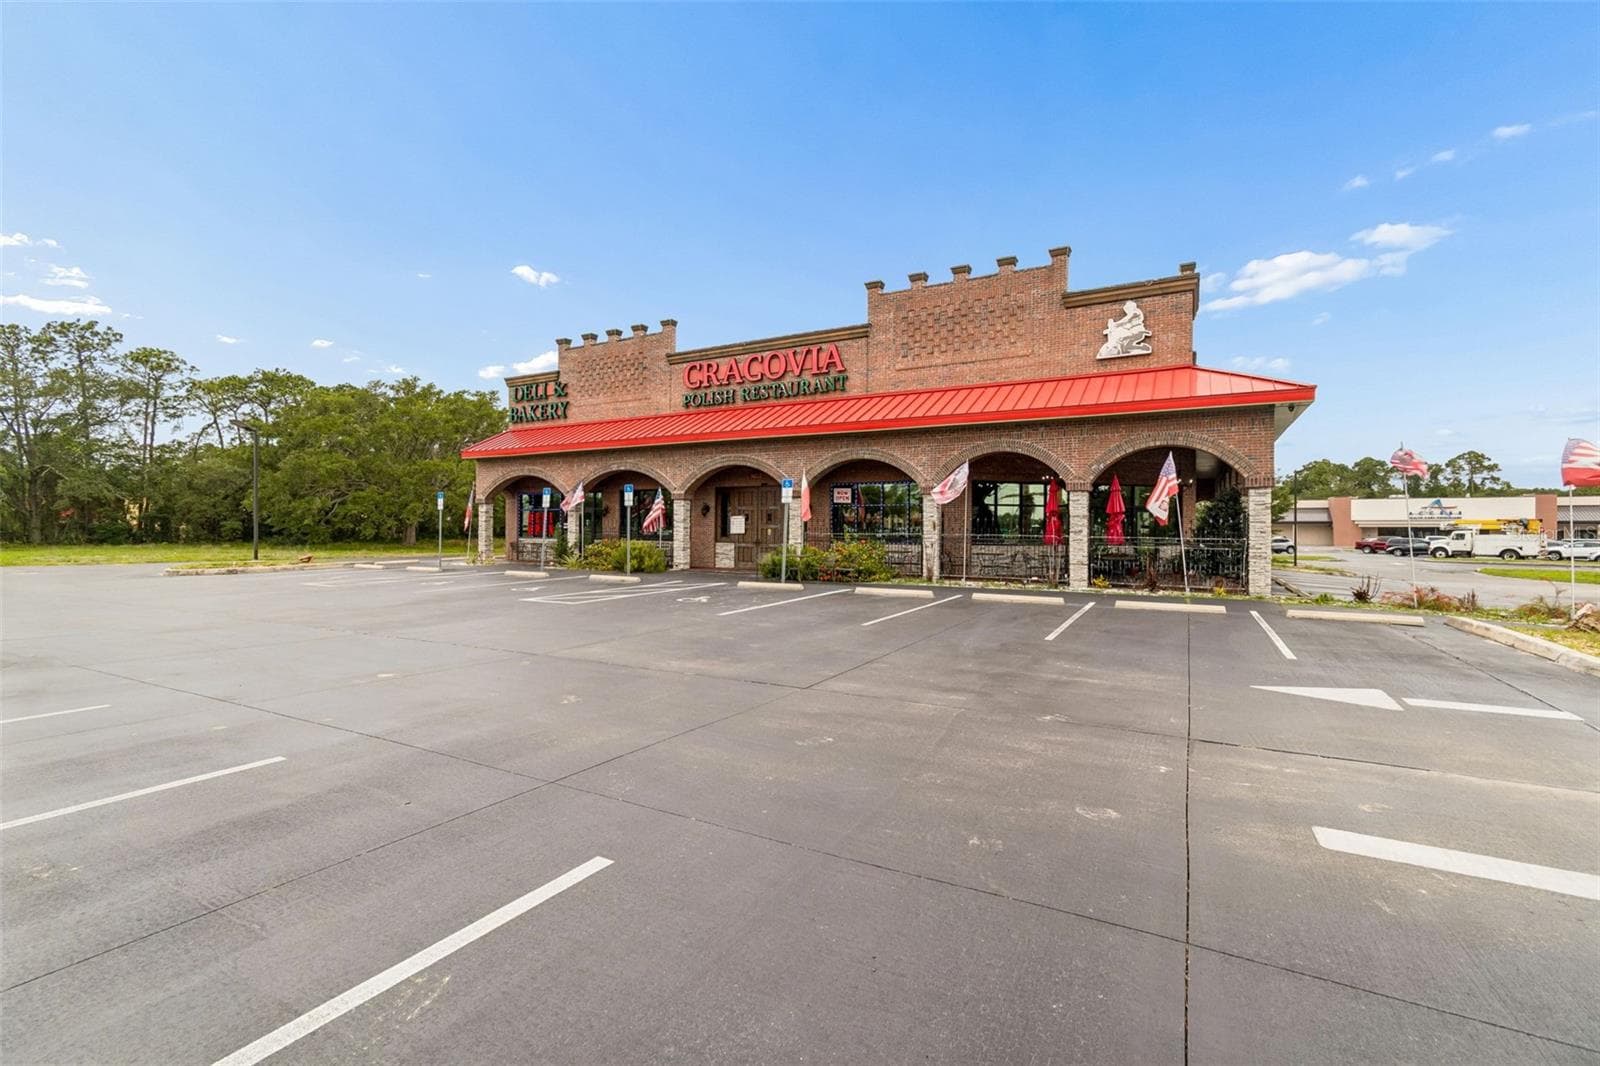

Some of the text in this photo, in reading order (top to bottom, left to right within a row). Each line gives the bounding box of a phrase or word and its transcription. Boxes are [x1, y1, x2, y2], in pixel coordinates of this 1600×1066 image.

[683, 342, 846, 389] CRACOVIA
[511, 380, 568, 402] DELI &
[682, 375, 848, 408] POLISH RESTAURANT
[509, 401, 569, 424] BAKERY
